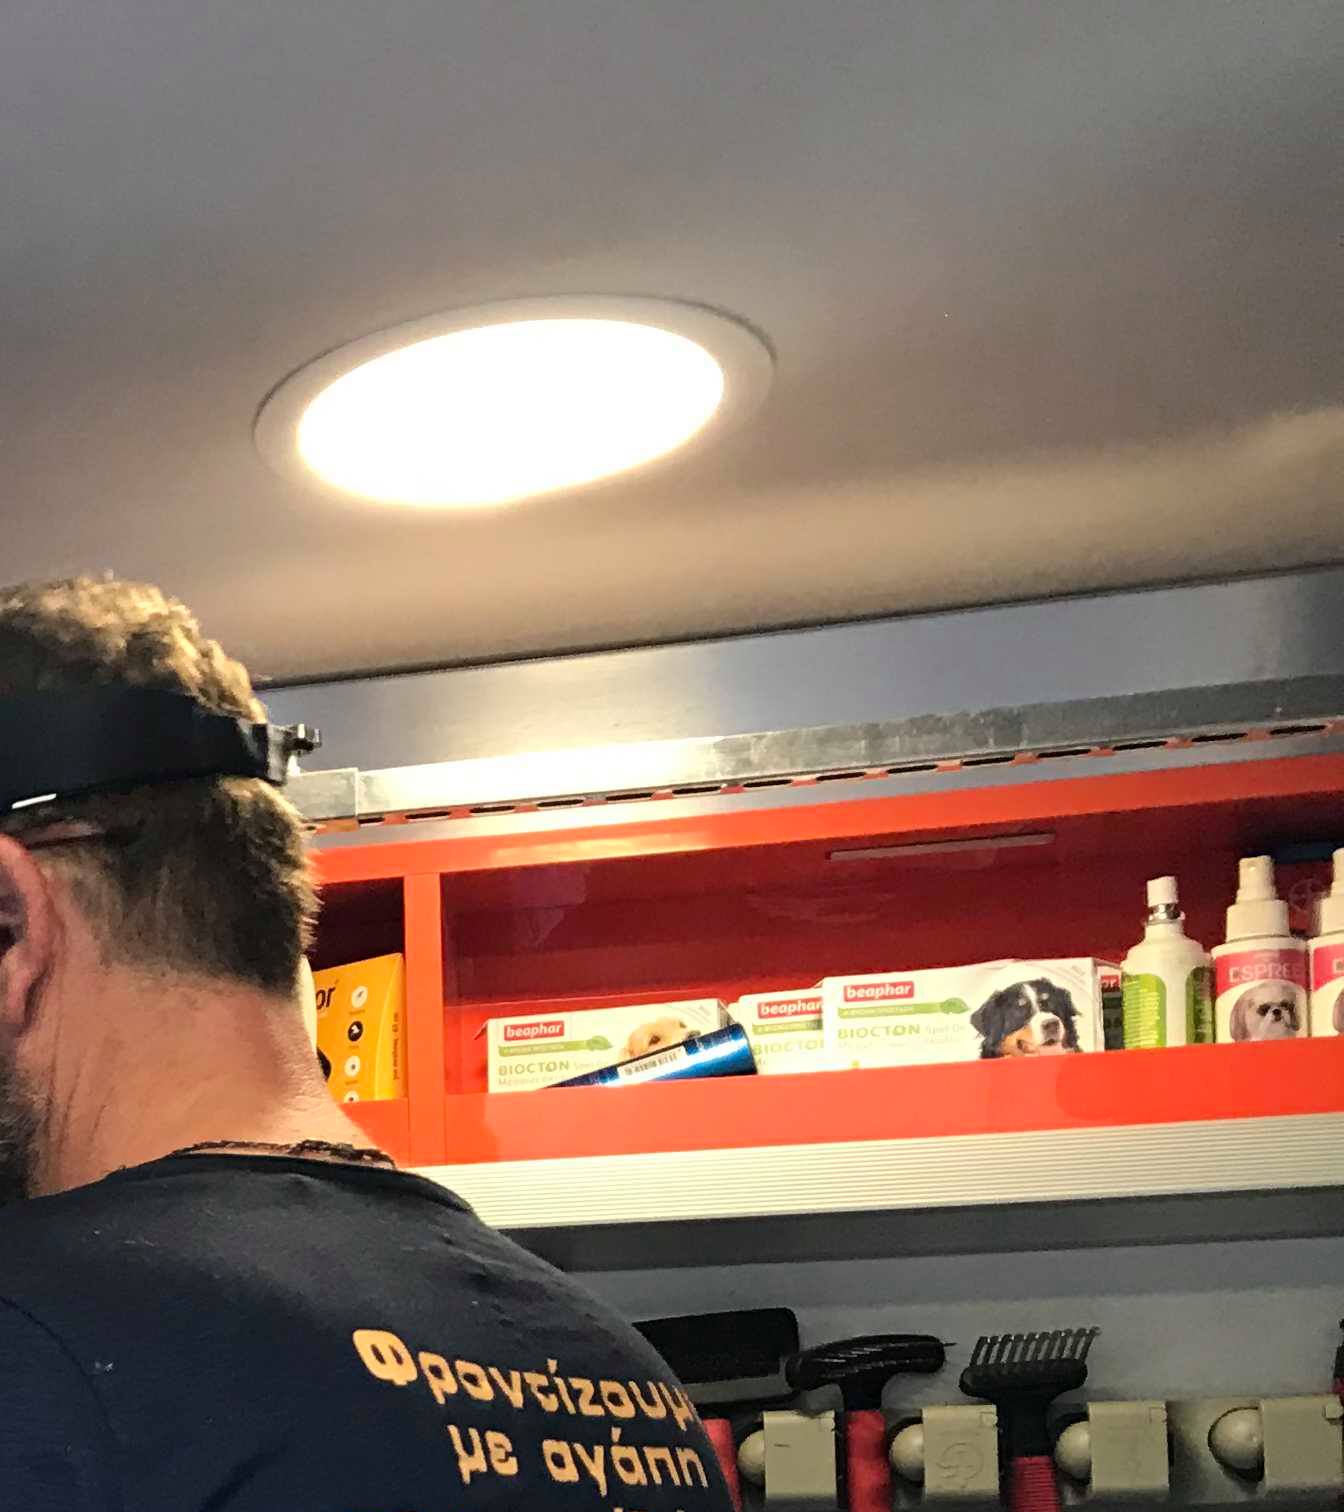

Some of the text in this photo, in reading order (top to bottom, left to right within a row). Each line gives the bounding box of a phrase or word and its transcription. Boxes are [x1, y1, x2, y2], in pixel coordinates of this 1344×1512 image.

[846, 984, 912, 999] beaphar
[506, 1023, 562, 1038] beaphar
[838, 1024, 921, 1039] BIOCTON
[499, 1061, 570, 1076] BIOCTON
[448, 1425, 708, 1497] με αγάπη
